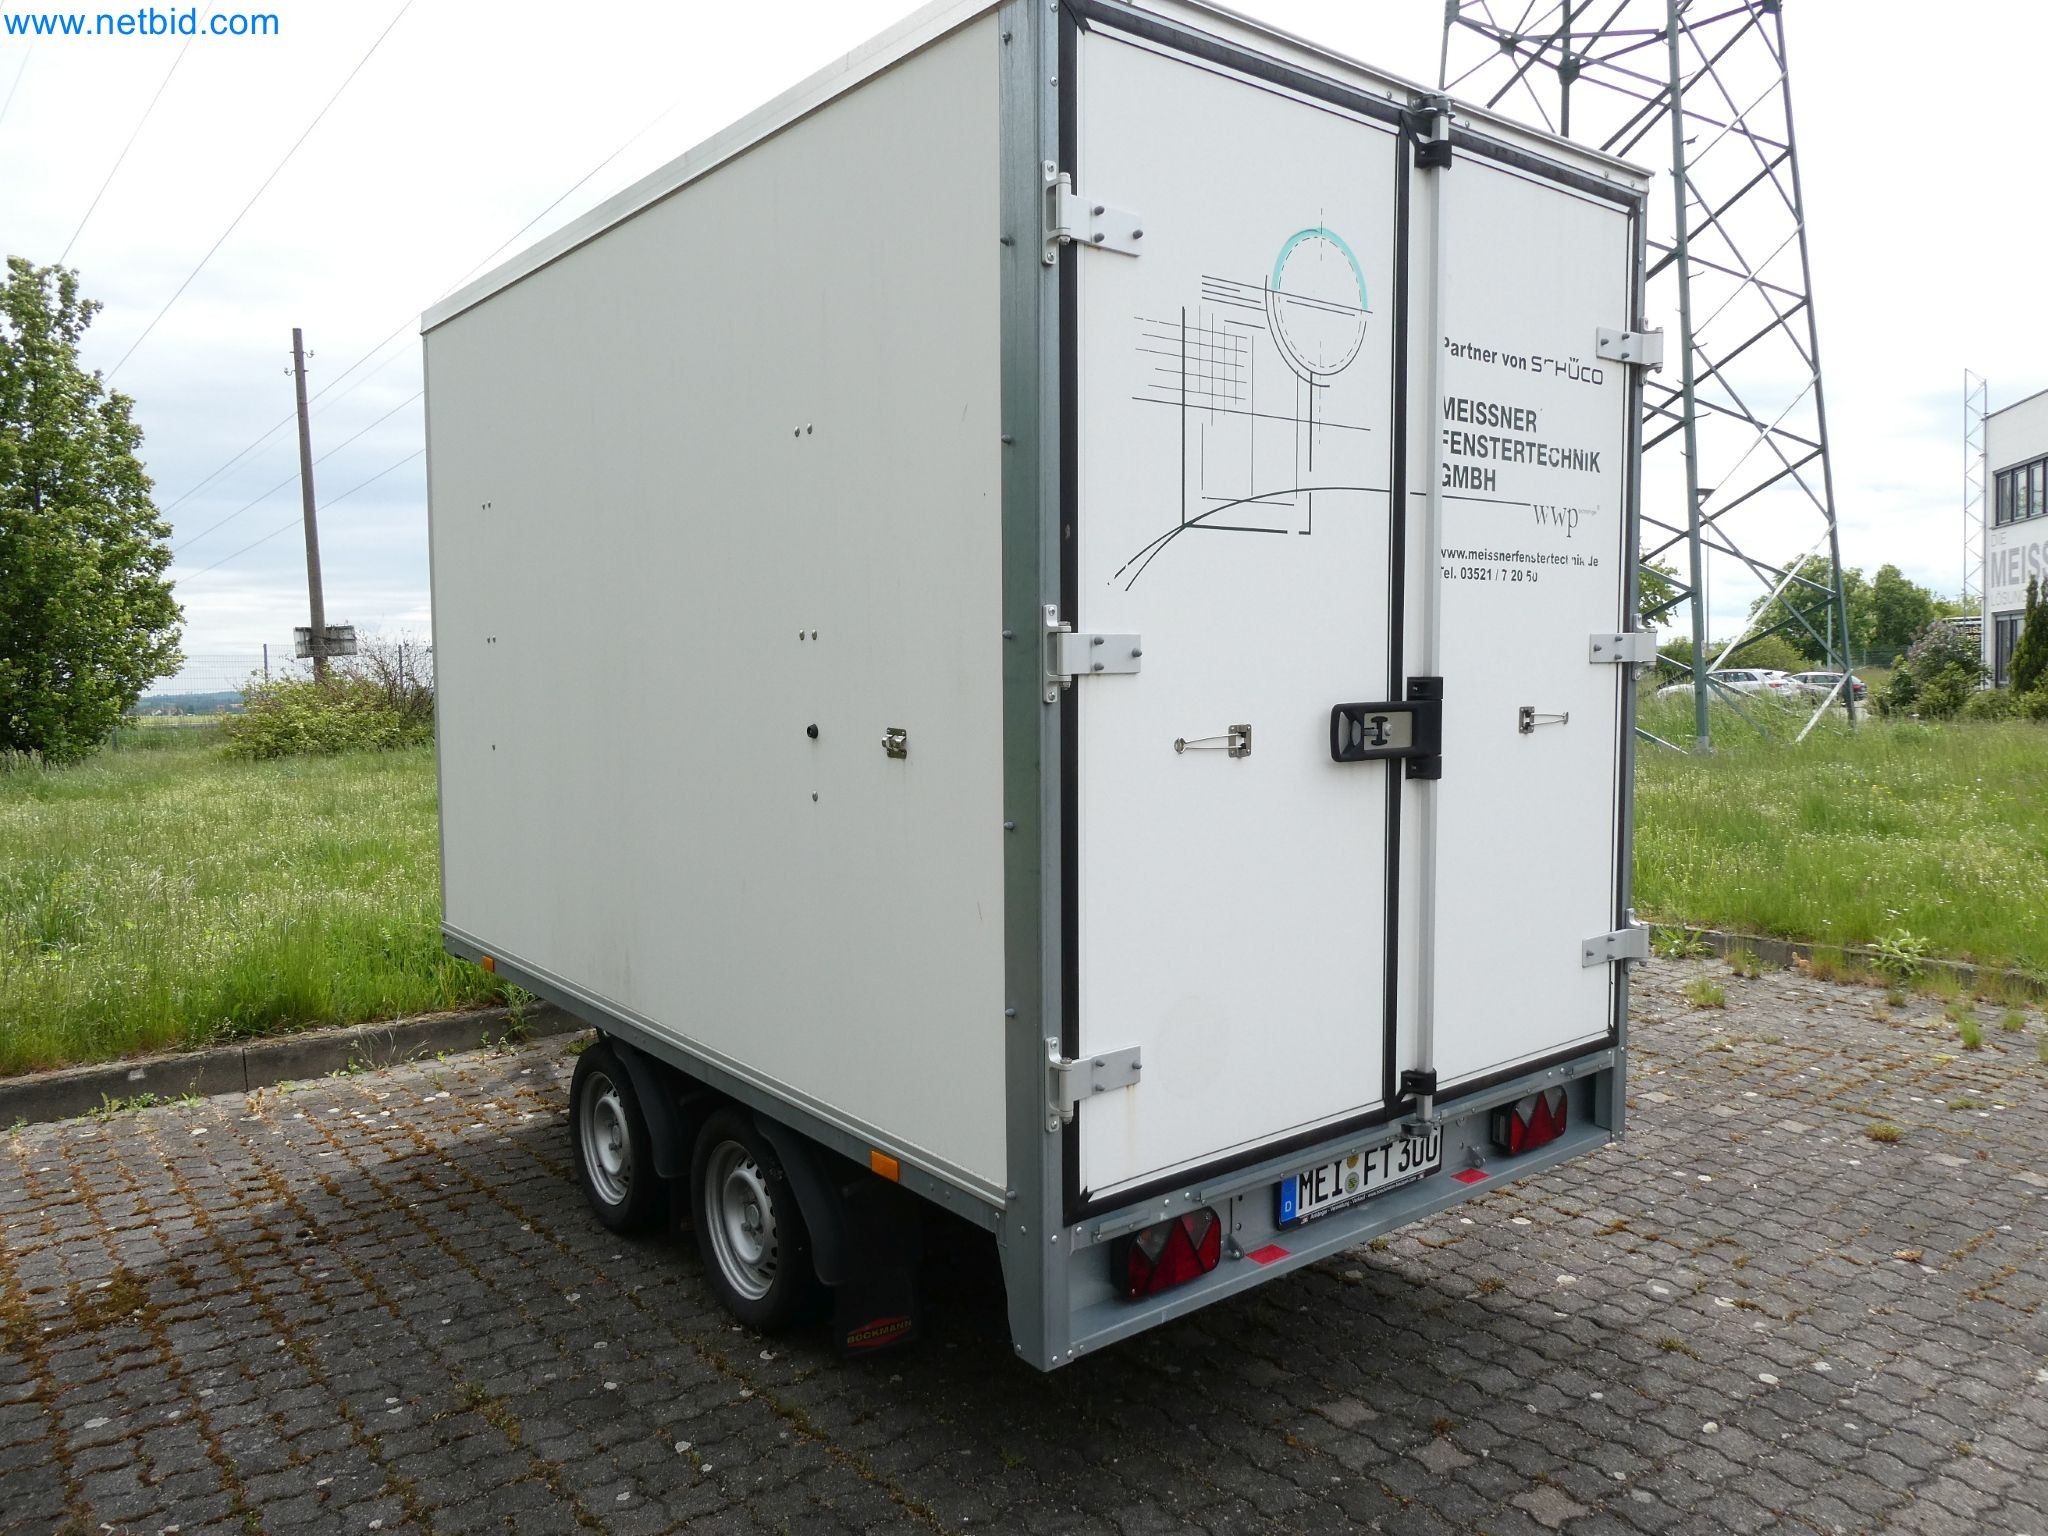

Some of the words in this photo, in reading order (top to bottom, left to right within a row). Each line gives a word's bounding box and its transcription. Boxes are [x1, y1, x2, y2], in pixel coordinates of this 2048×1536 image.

[1502, 353, 1527, 370] von
[1443, 396, 1537, 433] MEISSNER
[1441, 462, 1496, 491] GMBH
[1460, 566, 1492, 581] 03521
[1501, 569, 1508, 581] 7
[1511, 569, 1523, 582] 20
[1526, 570, 1538, 582] 50
[1298, 1159, 1343, 1210] MEI
[1363, 1143, 1394, 1186] FT
[1398, 1128, 1438, 1172] 300
[1284, 1200, 1292, 1212] D
